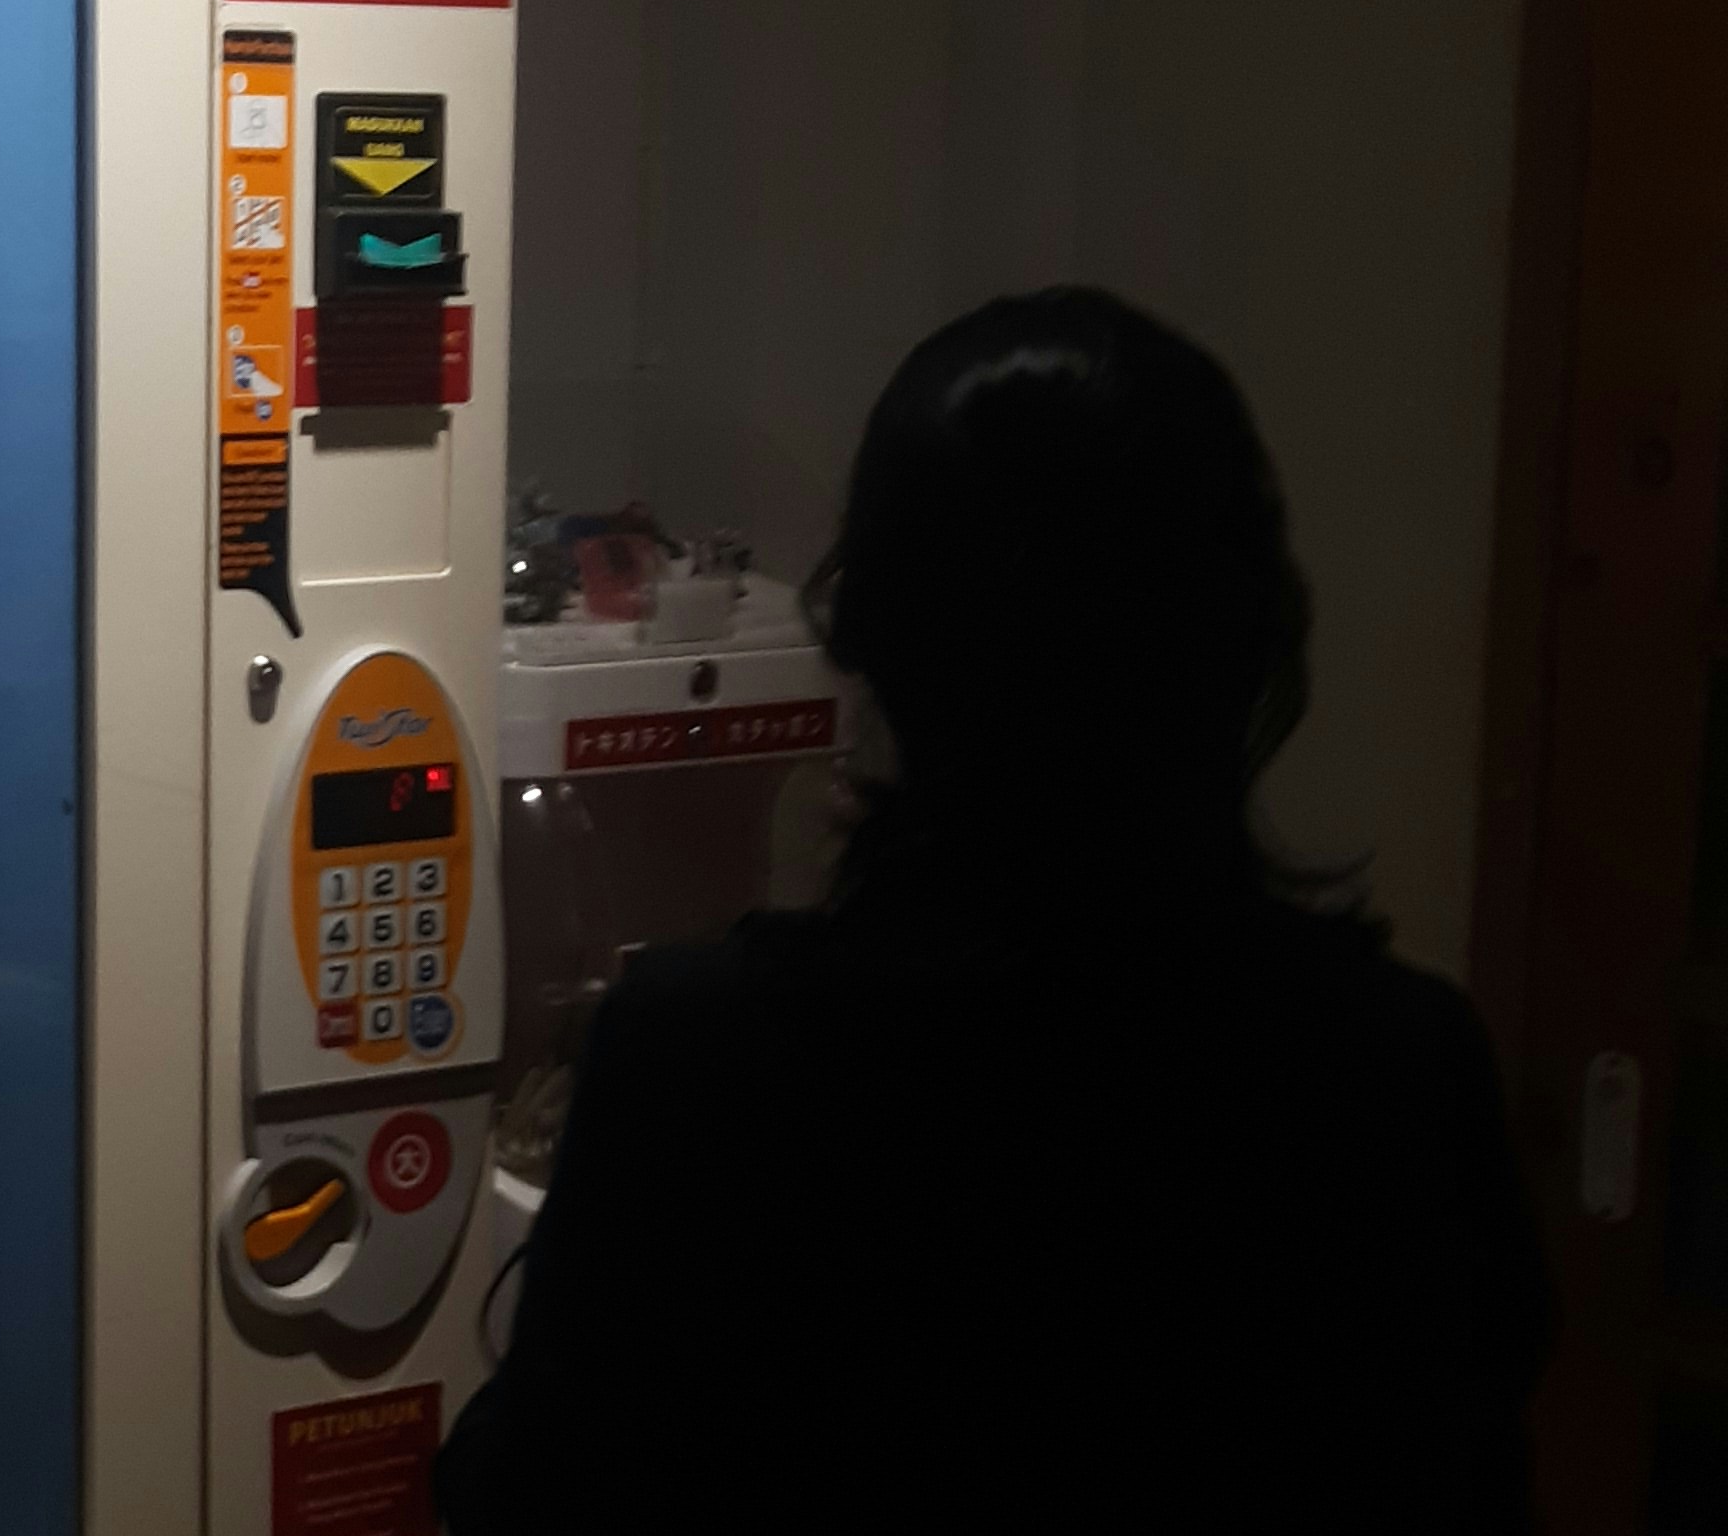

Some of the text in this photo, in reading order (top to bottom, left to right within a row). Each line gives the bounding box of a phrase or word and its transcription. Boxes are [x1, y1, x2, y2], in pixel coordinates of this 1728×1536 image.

[332, 864, 438, 902] 1 2 3
[328, 908, 436, 947] 4 5 6
[328, 954, 436, 993] 7 8 9
[373, 1006, 392, 1034] 0
